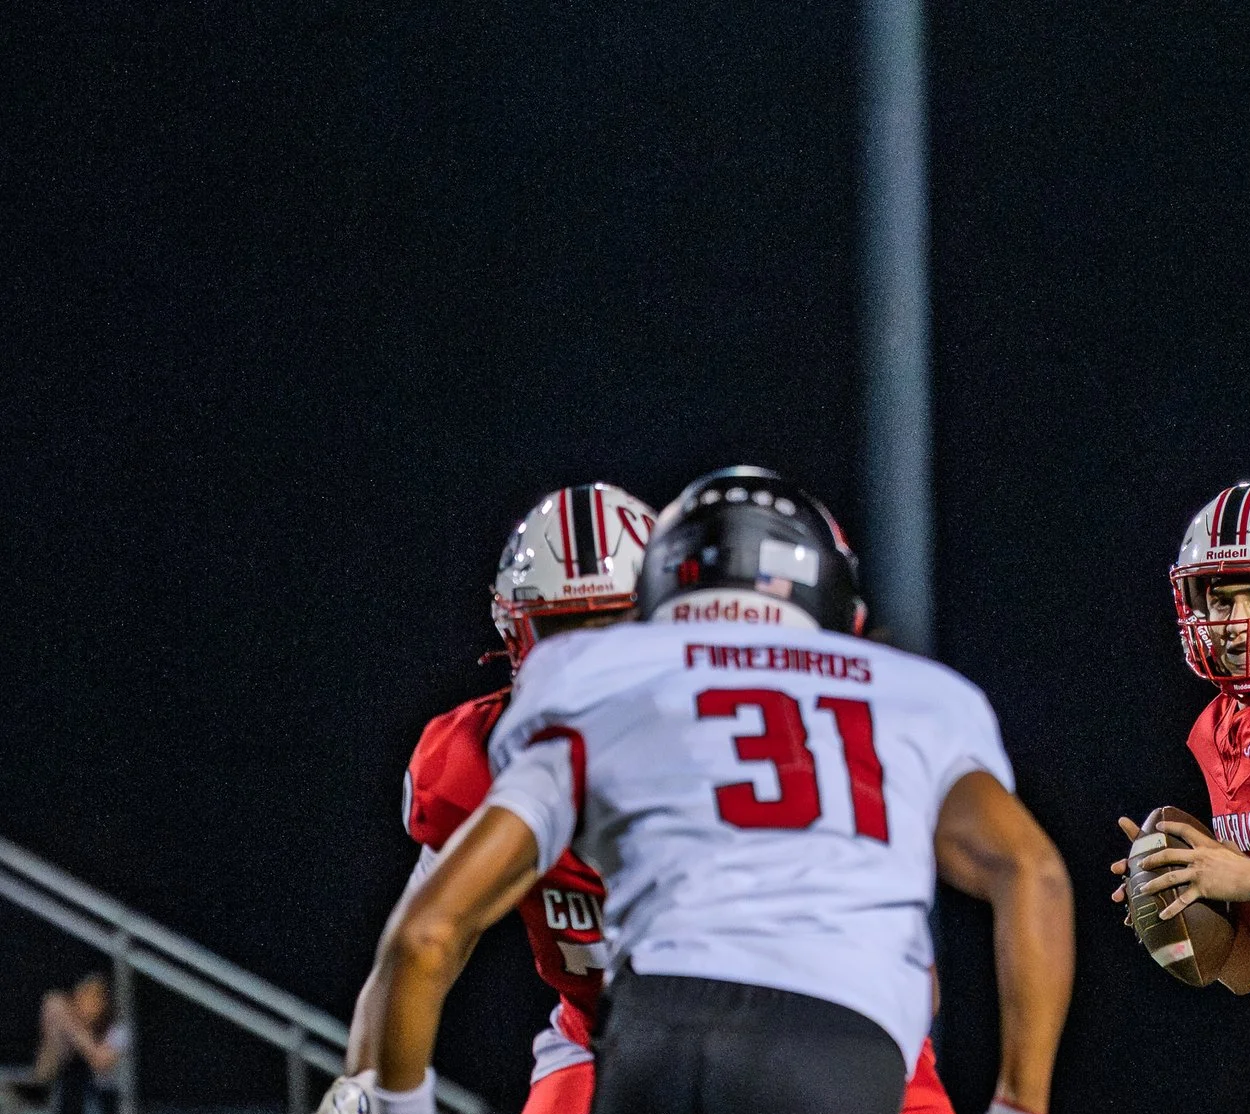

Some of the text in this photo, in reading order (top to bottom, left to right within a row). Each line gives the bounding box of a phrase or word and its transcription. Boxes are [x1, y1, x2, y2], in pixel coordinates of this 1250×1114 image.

[1206, 548, 1248, 560] Riddell
[673, 598, 782, 624] Riddell
[684, 643, 872, 685] FIREBIRDS
[696, 687, 890, 845] 31
